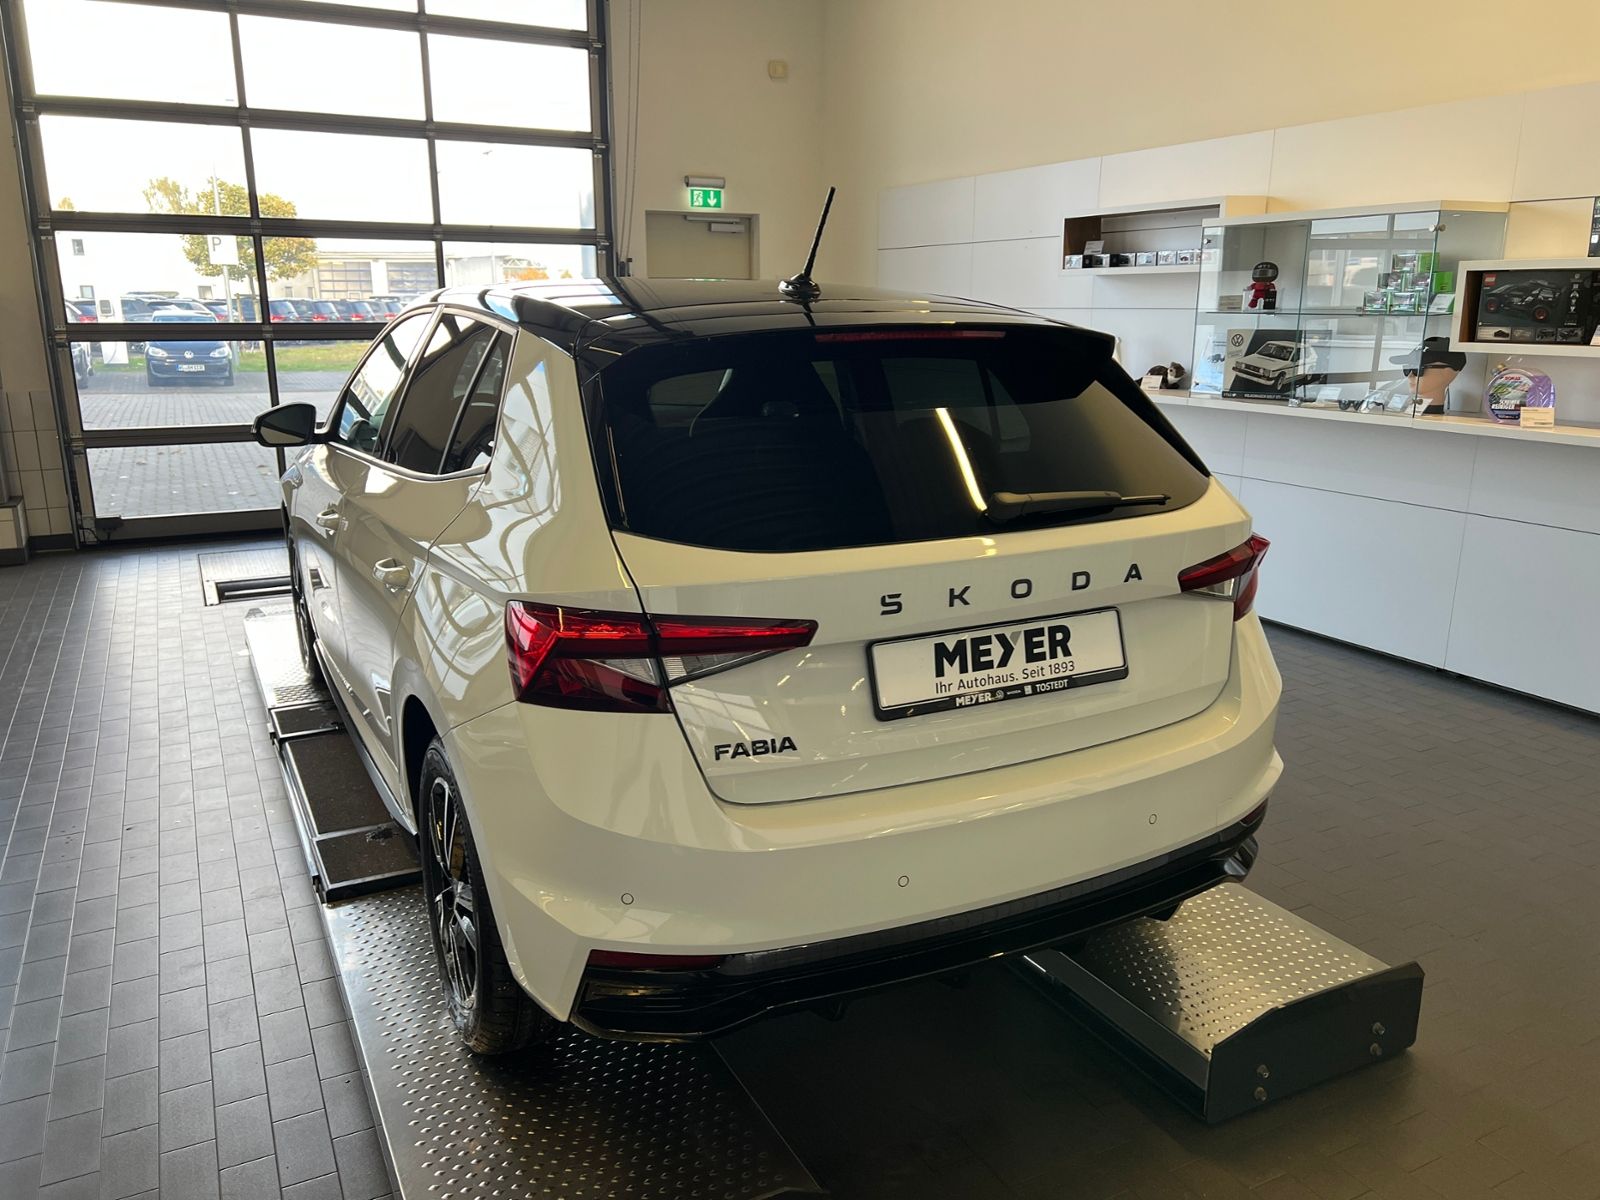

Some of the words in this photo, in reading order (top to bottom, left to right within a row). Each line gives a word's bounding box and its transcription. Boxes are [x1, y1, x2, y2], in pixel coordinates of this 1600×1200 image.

[212, 236, 222, 251] P
[934, 624, 1072, 678] MEYER
[935, 681, 953, 694] Ihr
[957, 672, 1019, 691] Autohaus.
[1022, 666, 1045, 680] Seit
[1048, 660, 1075, 676] 1893
[955, 691, 993, 707] MEYER
[1035, 679, 1069, 693] TOSTEDT
[714, 736, 798, 761] FABIA
